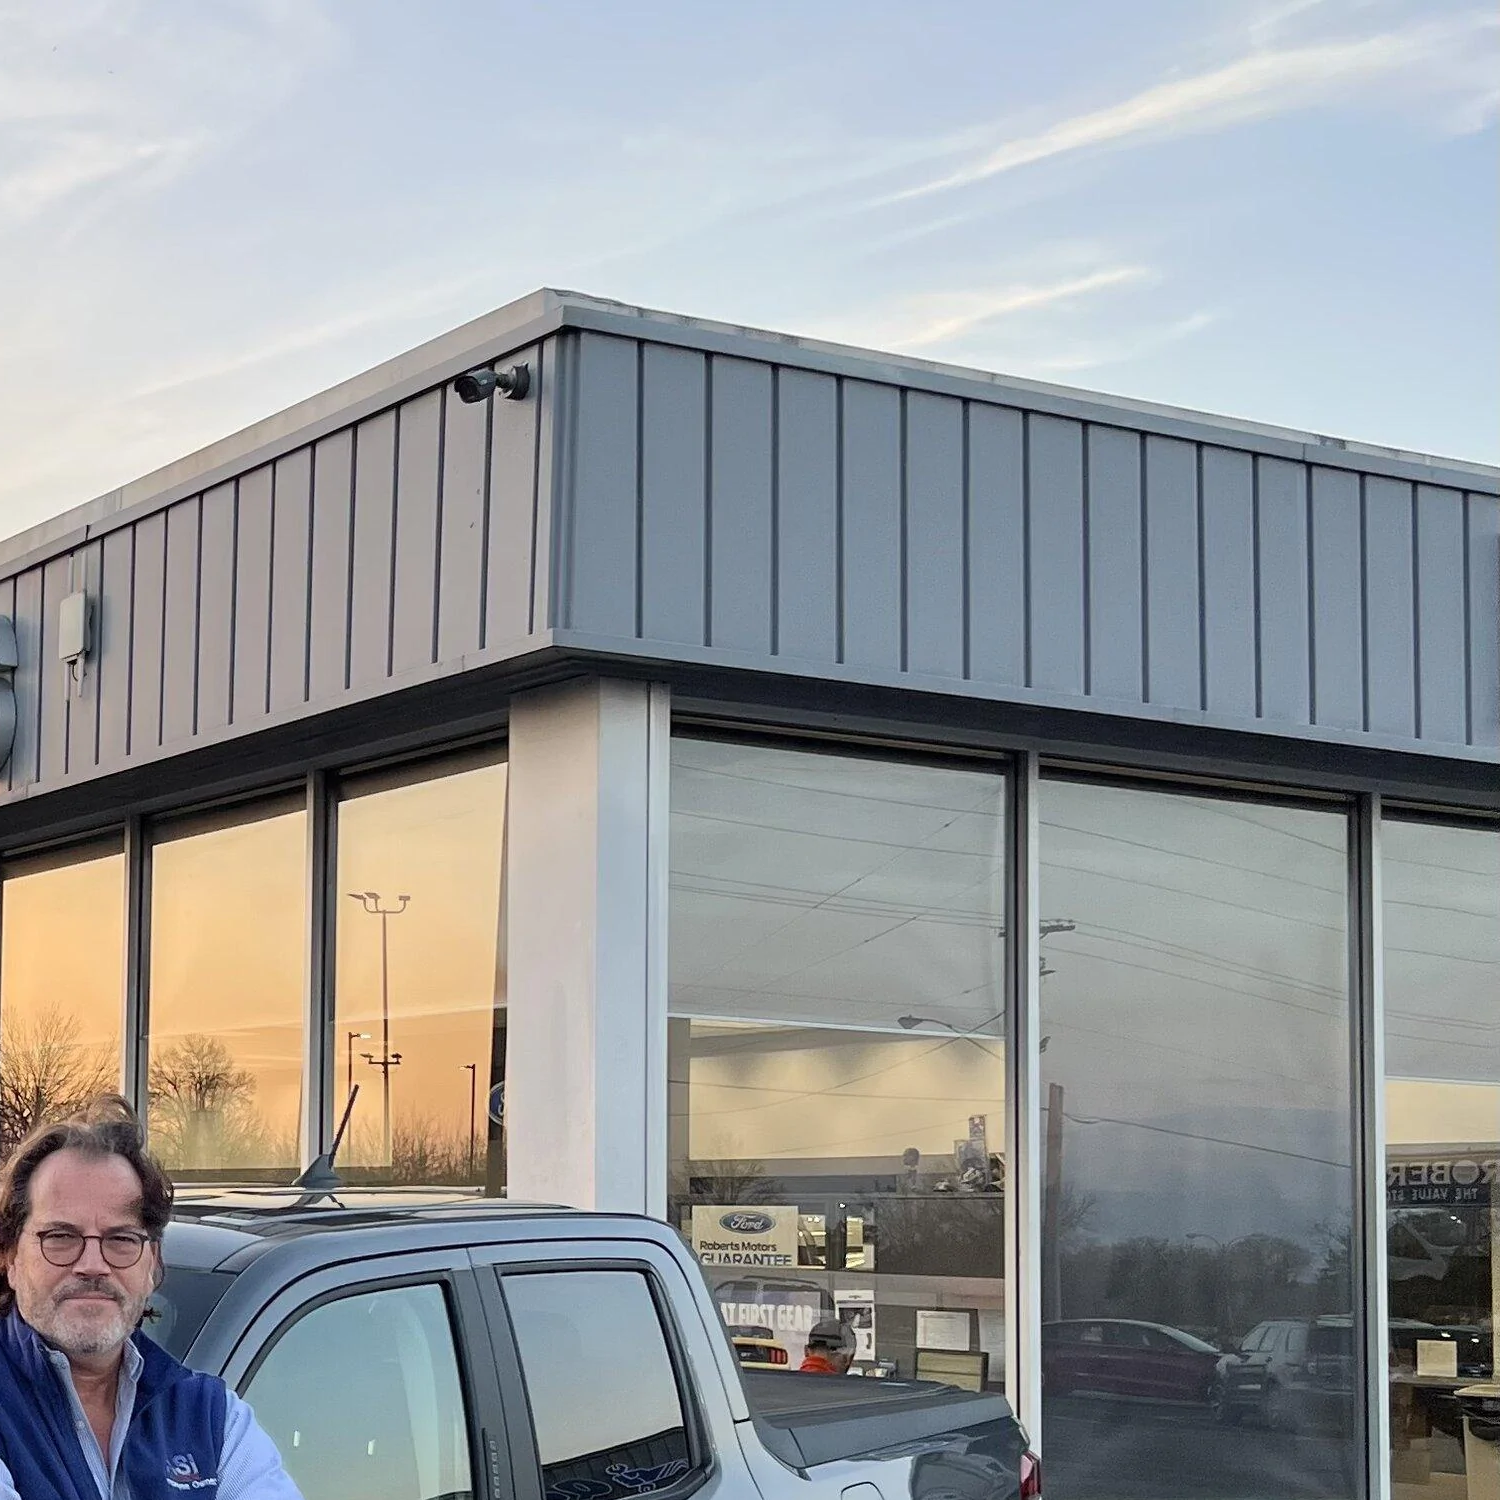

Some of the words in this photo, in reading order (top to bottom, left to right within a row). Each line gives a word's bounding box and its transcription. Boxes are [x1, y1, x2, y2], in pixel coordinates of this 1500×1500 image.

[731, 1214, 764, 1229] Ford
[700, 1240, 740, 1251] Roberts
[741, 1241, 777, 1252] Motors
[701, 1253, 792, 1266] GUARANTEE
[739, 1303, 775, 1328] FIRST
[777, 1304, 813, 1331] GEAR
